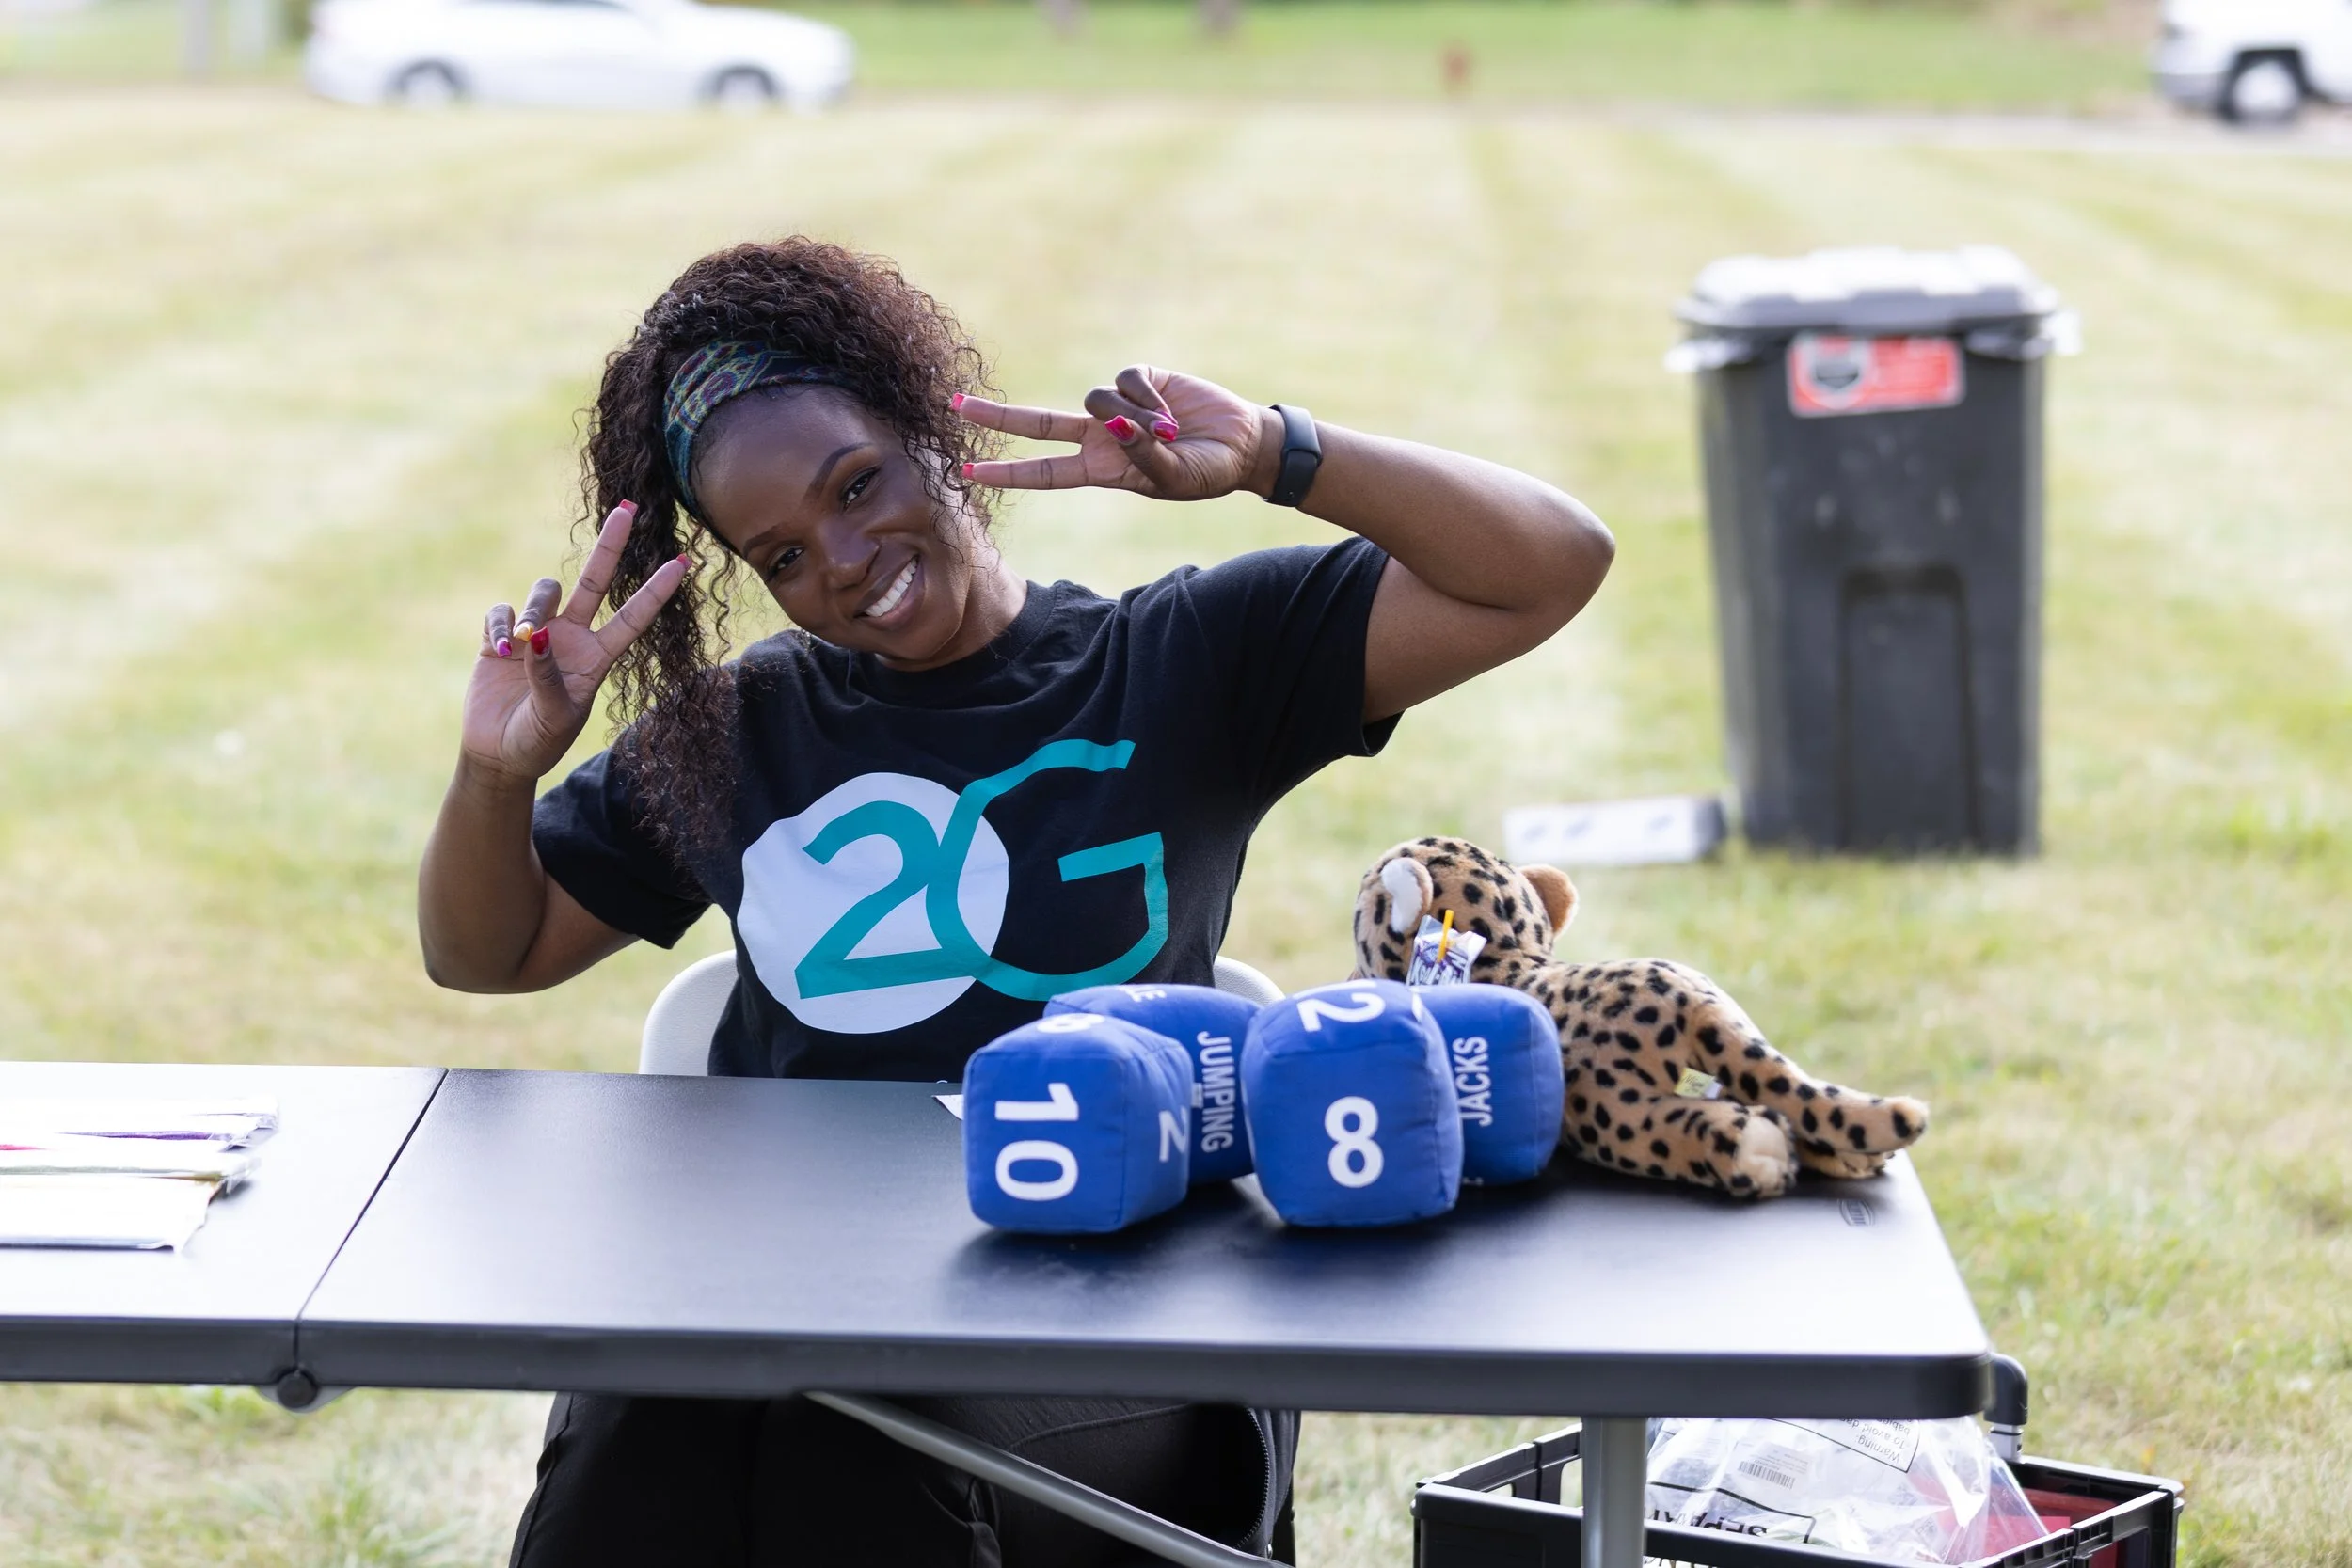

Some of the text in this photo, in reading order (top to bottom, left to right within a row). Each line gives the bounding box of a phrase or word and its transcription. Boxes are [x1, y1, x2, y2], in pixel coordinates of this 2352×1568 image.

[794, 739, 1168, 1002] 2G
[1196, 1031, 1234, 1153] JUMPING
[1452, 1037, 1493, 1127] JACKS
[994, 1082, 1079, 1201] 10
[1324, 1096, 1384, 1188] 8
[1855, 1434, 1900, 1464] Warning:
